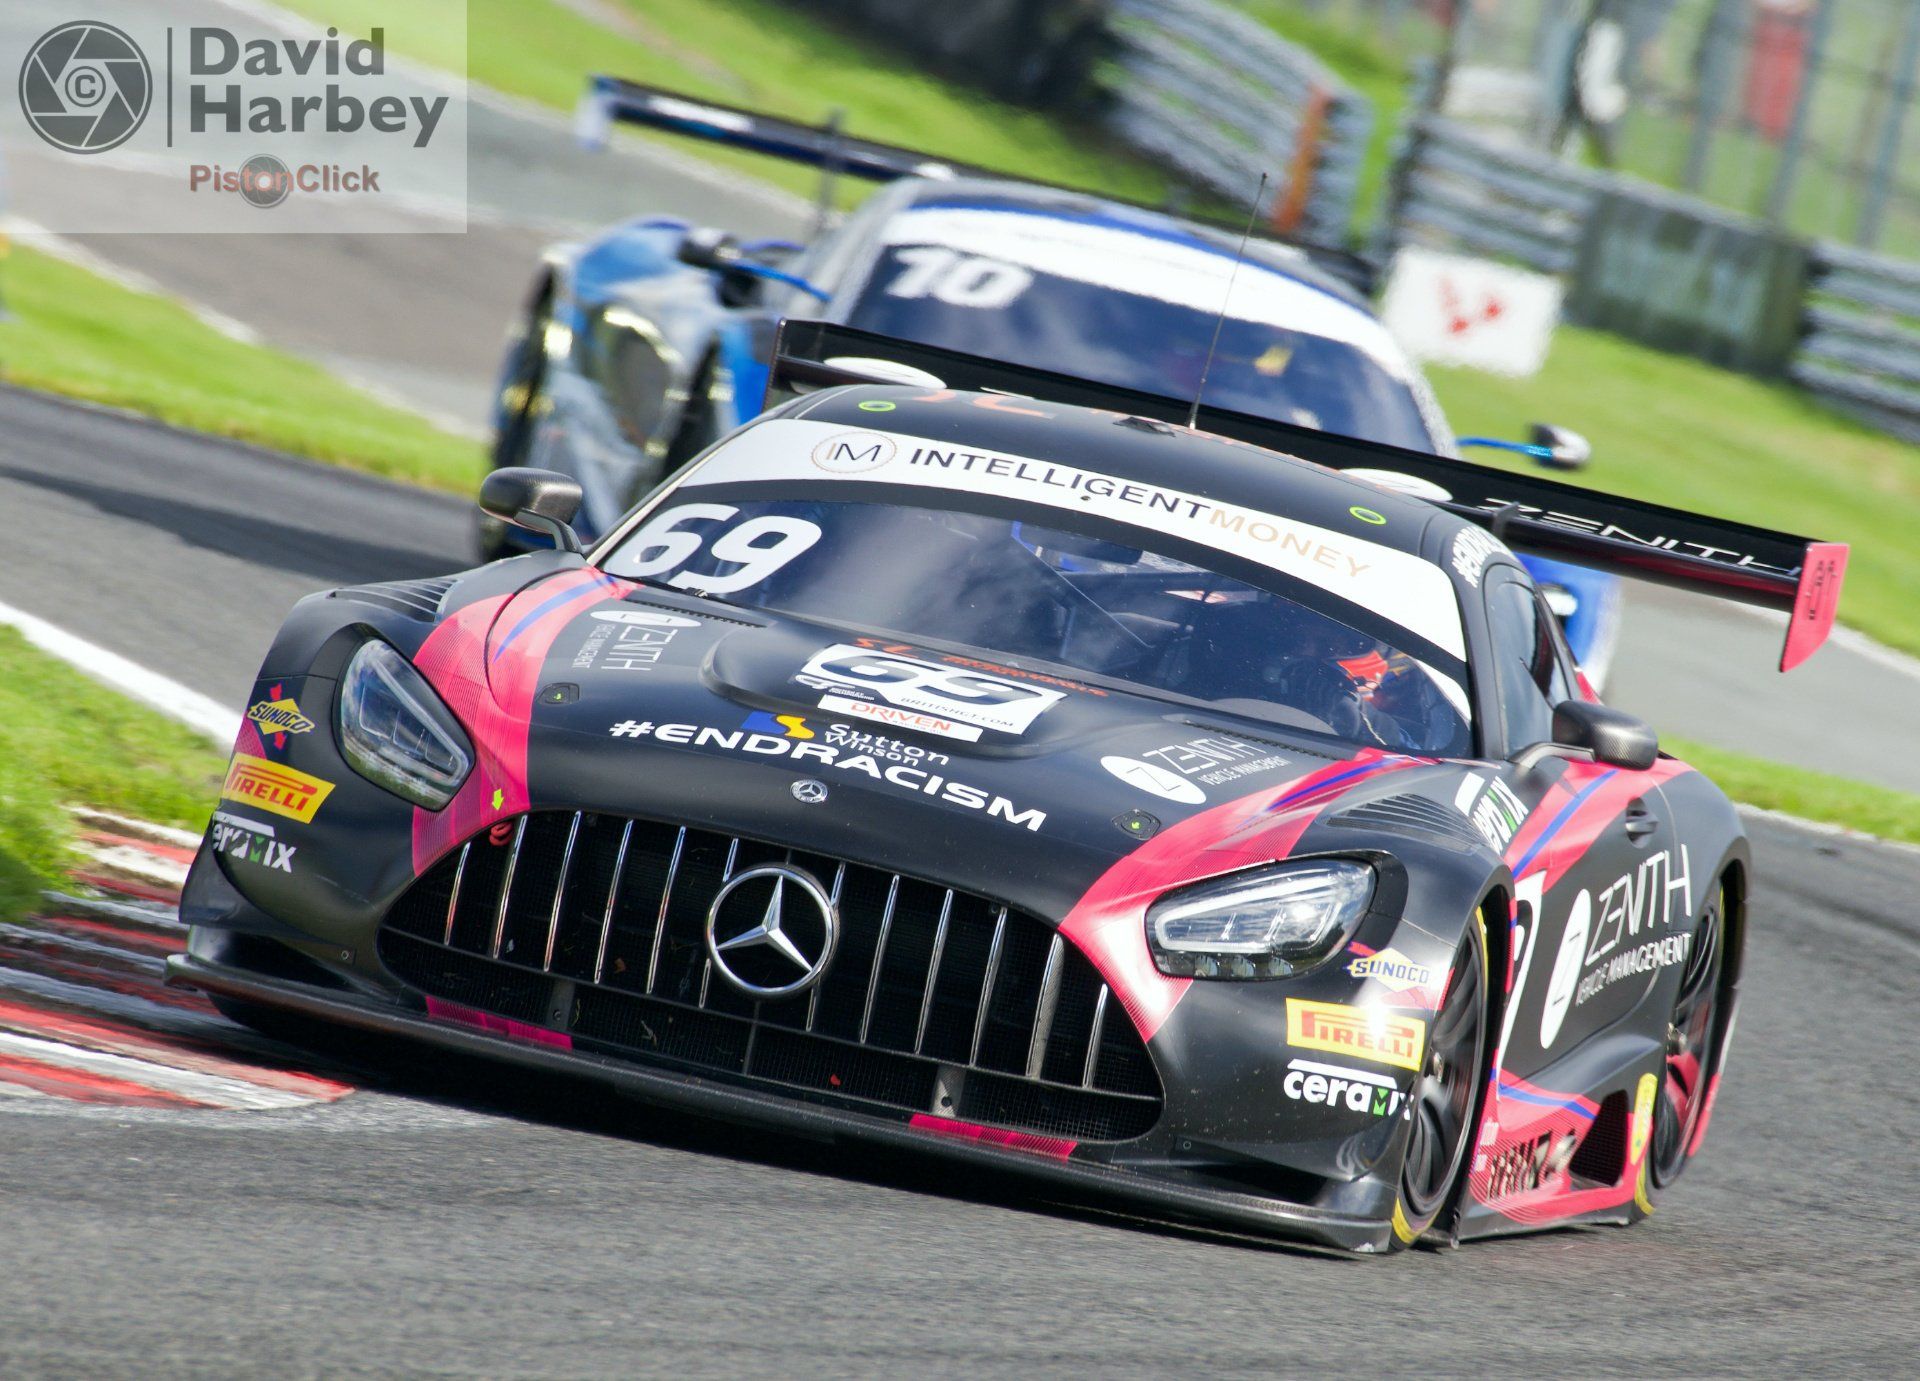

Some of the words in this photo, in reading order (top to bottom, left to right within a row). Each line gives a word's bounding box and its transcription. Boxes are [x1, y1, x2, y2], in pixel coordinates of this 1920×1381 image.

[884, 249, 1035, 310] 10
[602, 502, 823, 595] 69
[250, 703, 311, 732] SUNOCO
[850, 701, 952, 732] DRIVEN
[825, 731, 919, 767] Winson
[828, 723, 950, 766] Sutton
[1142, 736, 1267, 775] ZENITH
[225, 762, 319, 812] PIRELLI
[608, 719, 1047, 832] #ENDRACISM
[1584, 843, 1692, 967] ZENITH
[1354, 960, 1430, 985] SUNOCO
[1301, 1010, 1416, 1059] PIRELLI
